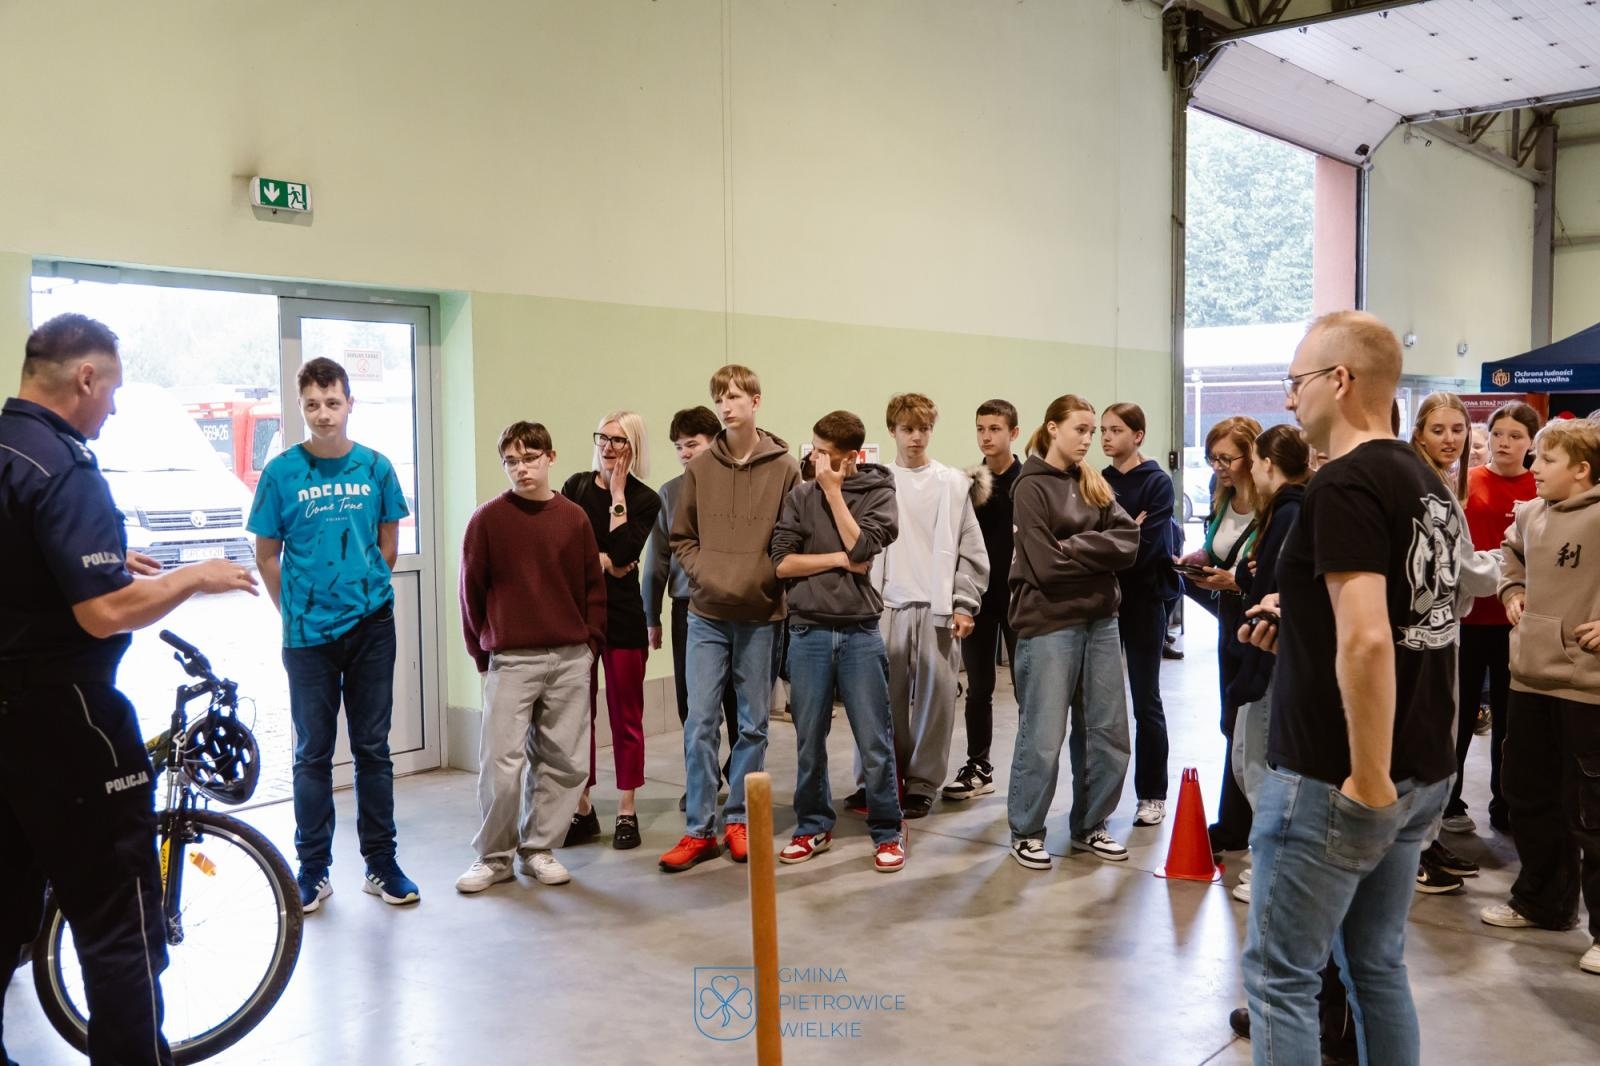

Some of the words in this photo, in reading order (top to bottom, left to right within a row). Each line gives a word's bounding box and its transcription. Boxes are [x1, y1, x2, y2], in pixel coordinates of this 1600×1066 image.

[1518, 376, 1542, 384] obrona
[1543, 376, 1570, 384] cywilna
[1544, 368, 1573, 376] ludności
[297, 483, 371, 502] DREAMS
[305, 500, 335, 519] Come
[338, 496, 363, 513] True
[105, 771, 149, 794] POLICJA
